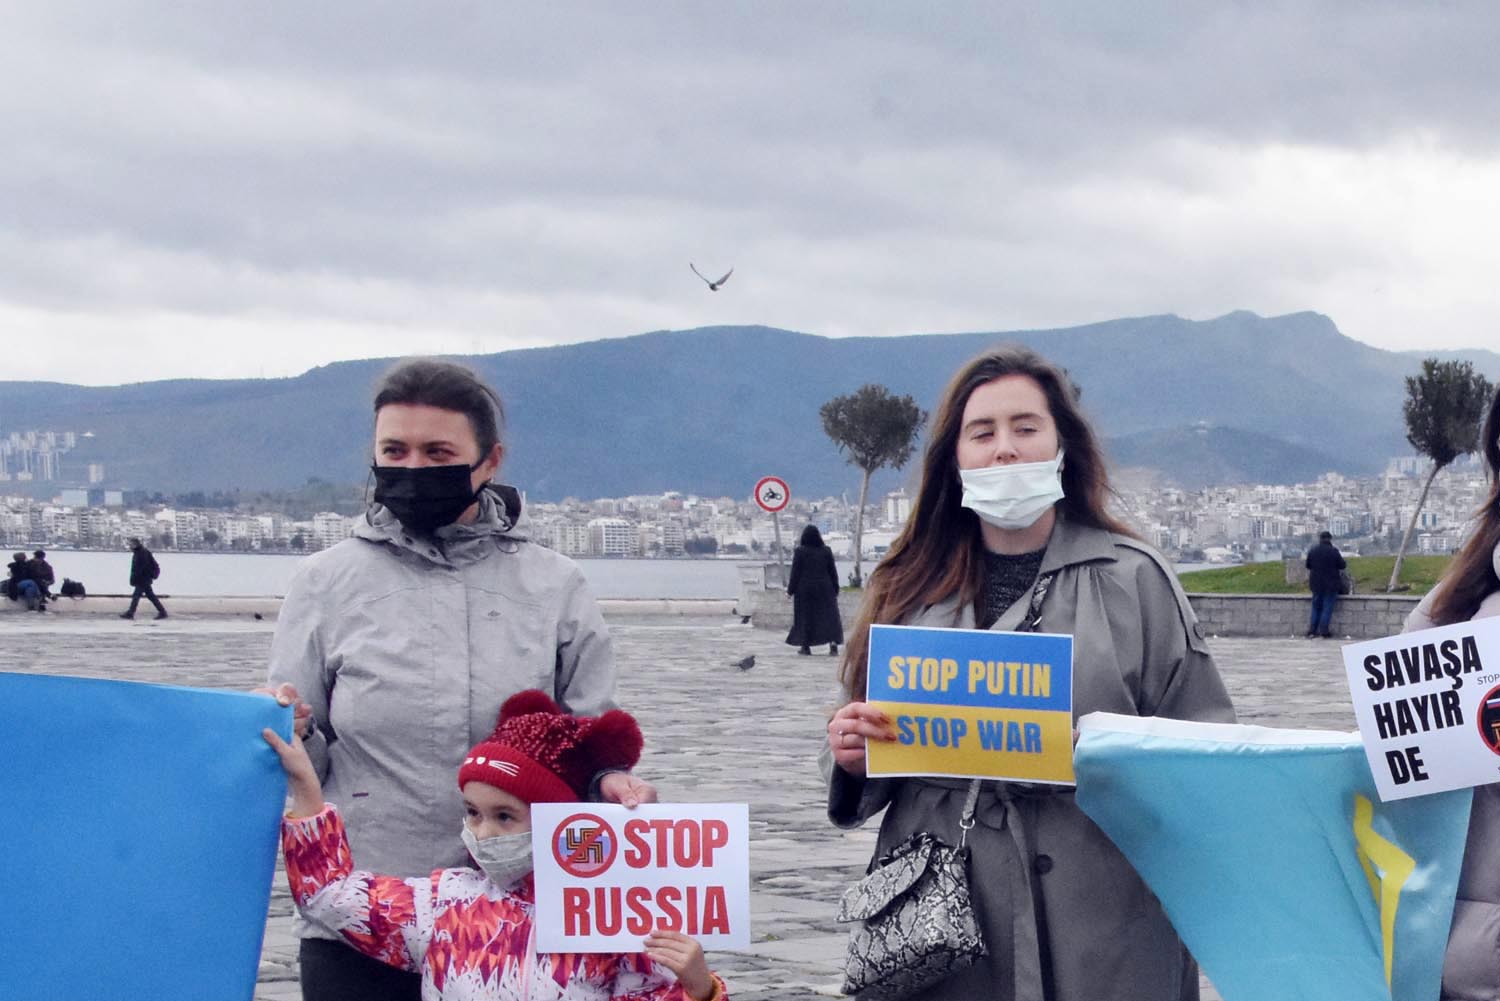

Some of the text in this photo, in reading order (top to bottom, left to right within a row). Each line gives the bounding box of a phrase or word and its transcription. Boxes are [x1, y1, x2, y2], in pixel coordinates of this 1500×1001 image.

[888, 656, 1051, 698] STOP PUTIN
[1363, 635, 1483, 691] SAVAŞA
[1477, 673, 1500, 686] STOP
[896, 715, 1043, 754] STOP WAR
[1373, 690, 1465, 740] HAYIR
[1385, 746, 1430, 785] DE
[624, 818, 729, 869] STOP
[563, 886, 730, 937] RUSSIA
